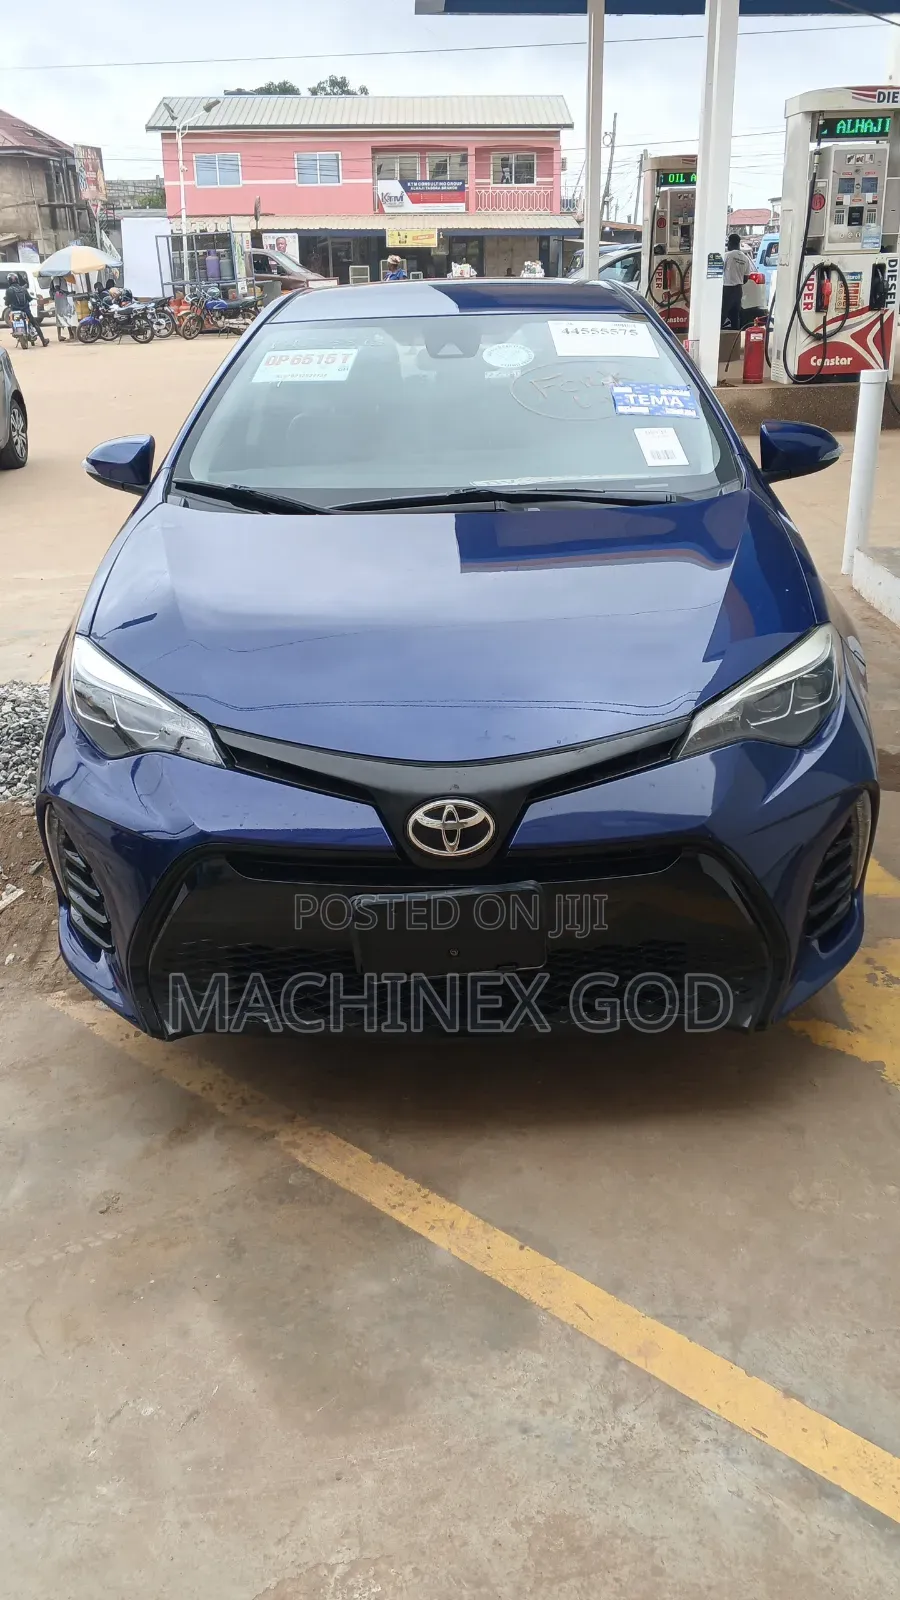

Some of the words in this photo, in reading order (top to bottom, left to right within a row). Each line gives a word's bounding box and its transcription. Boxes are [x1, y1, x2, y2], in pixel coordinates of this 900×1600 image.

[836, 118, 892, 134] ALHAJI
[668, 173, 686, 183] OIL
[886, 259, 898, 308] DIESEL
[561, 327, 638, 336] 44555575
[624, 394, 685, 408] TEMA
